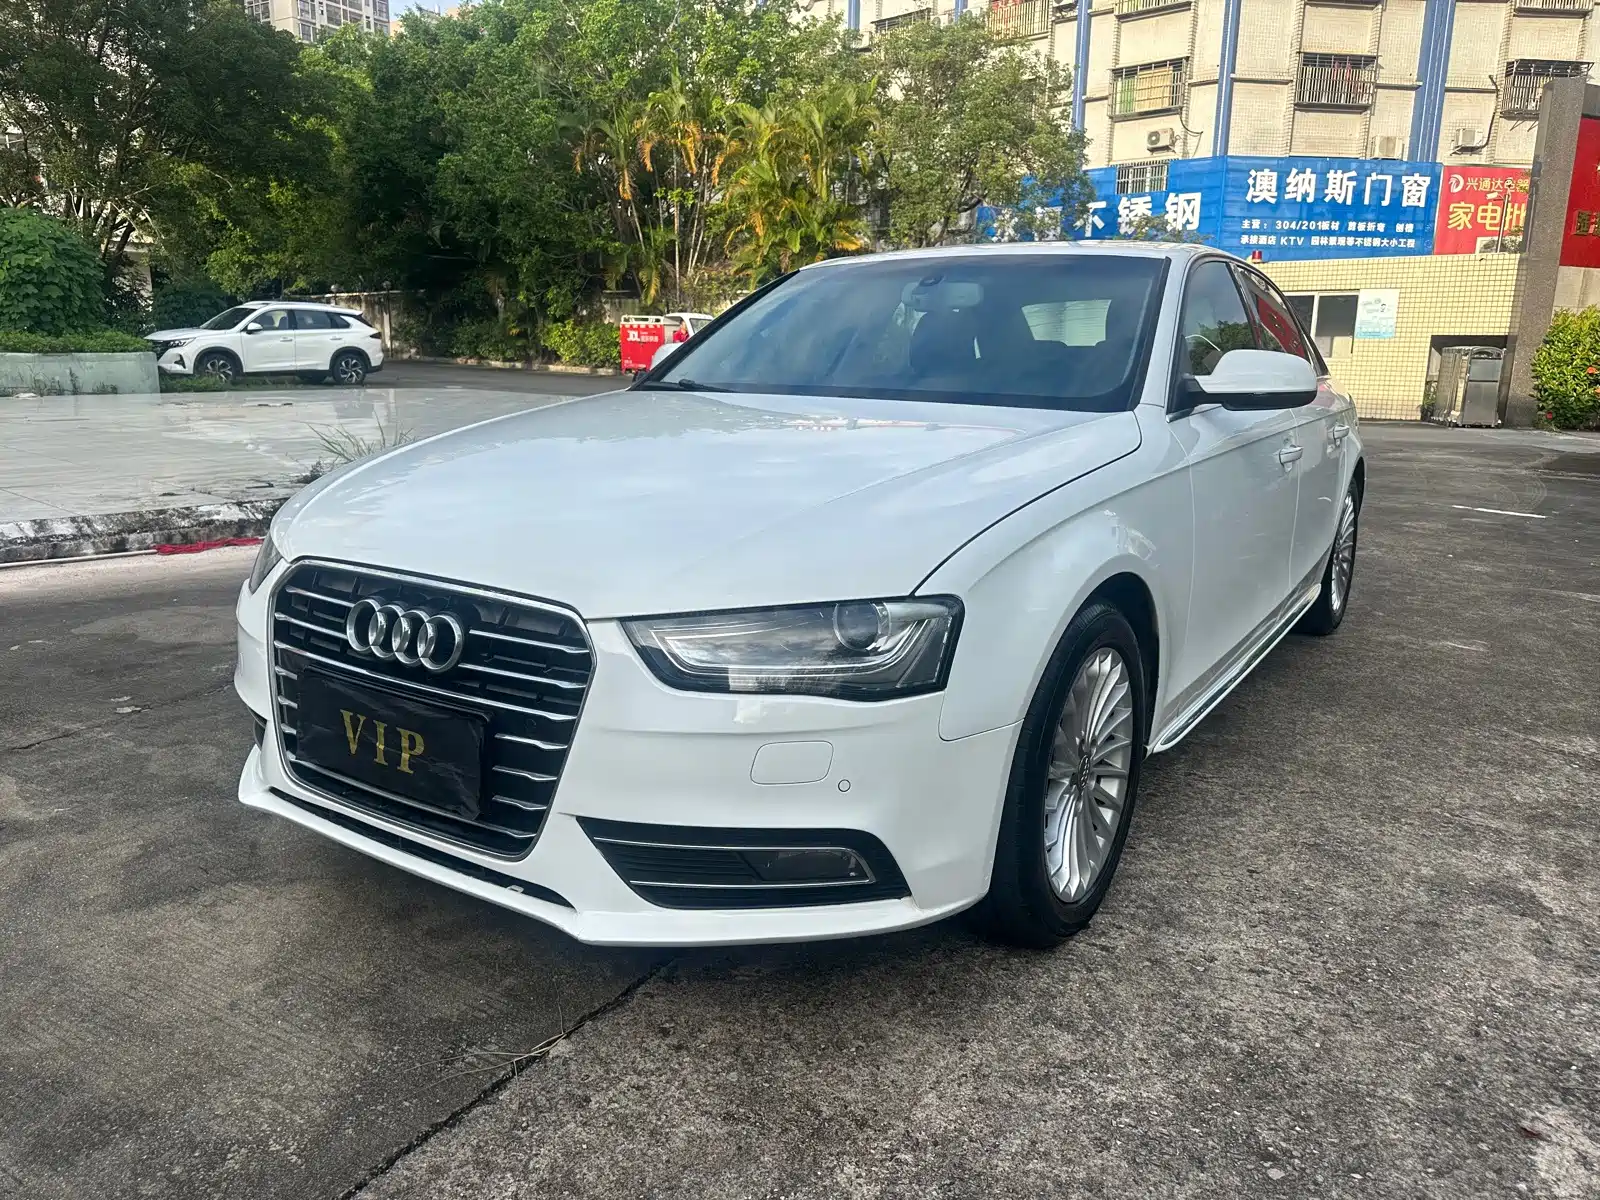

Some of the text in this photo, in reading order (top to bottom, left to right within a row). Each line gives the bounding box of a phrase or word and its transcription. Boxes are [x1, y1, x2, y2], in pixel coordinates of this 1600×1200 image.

[1247, 168, 1430, 207] 澳纳斯门窗
[1280, 237, 1304, 246] KTV
[340, 709, 424, 774] VIP
